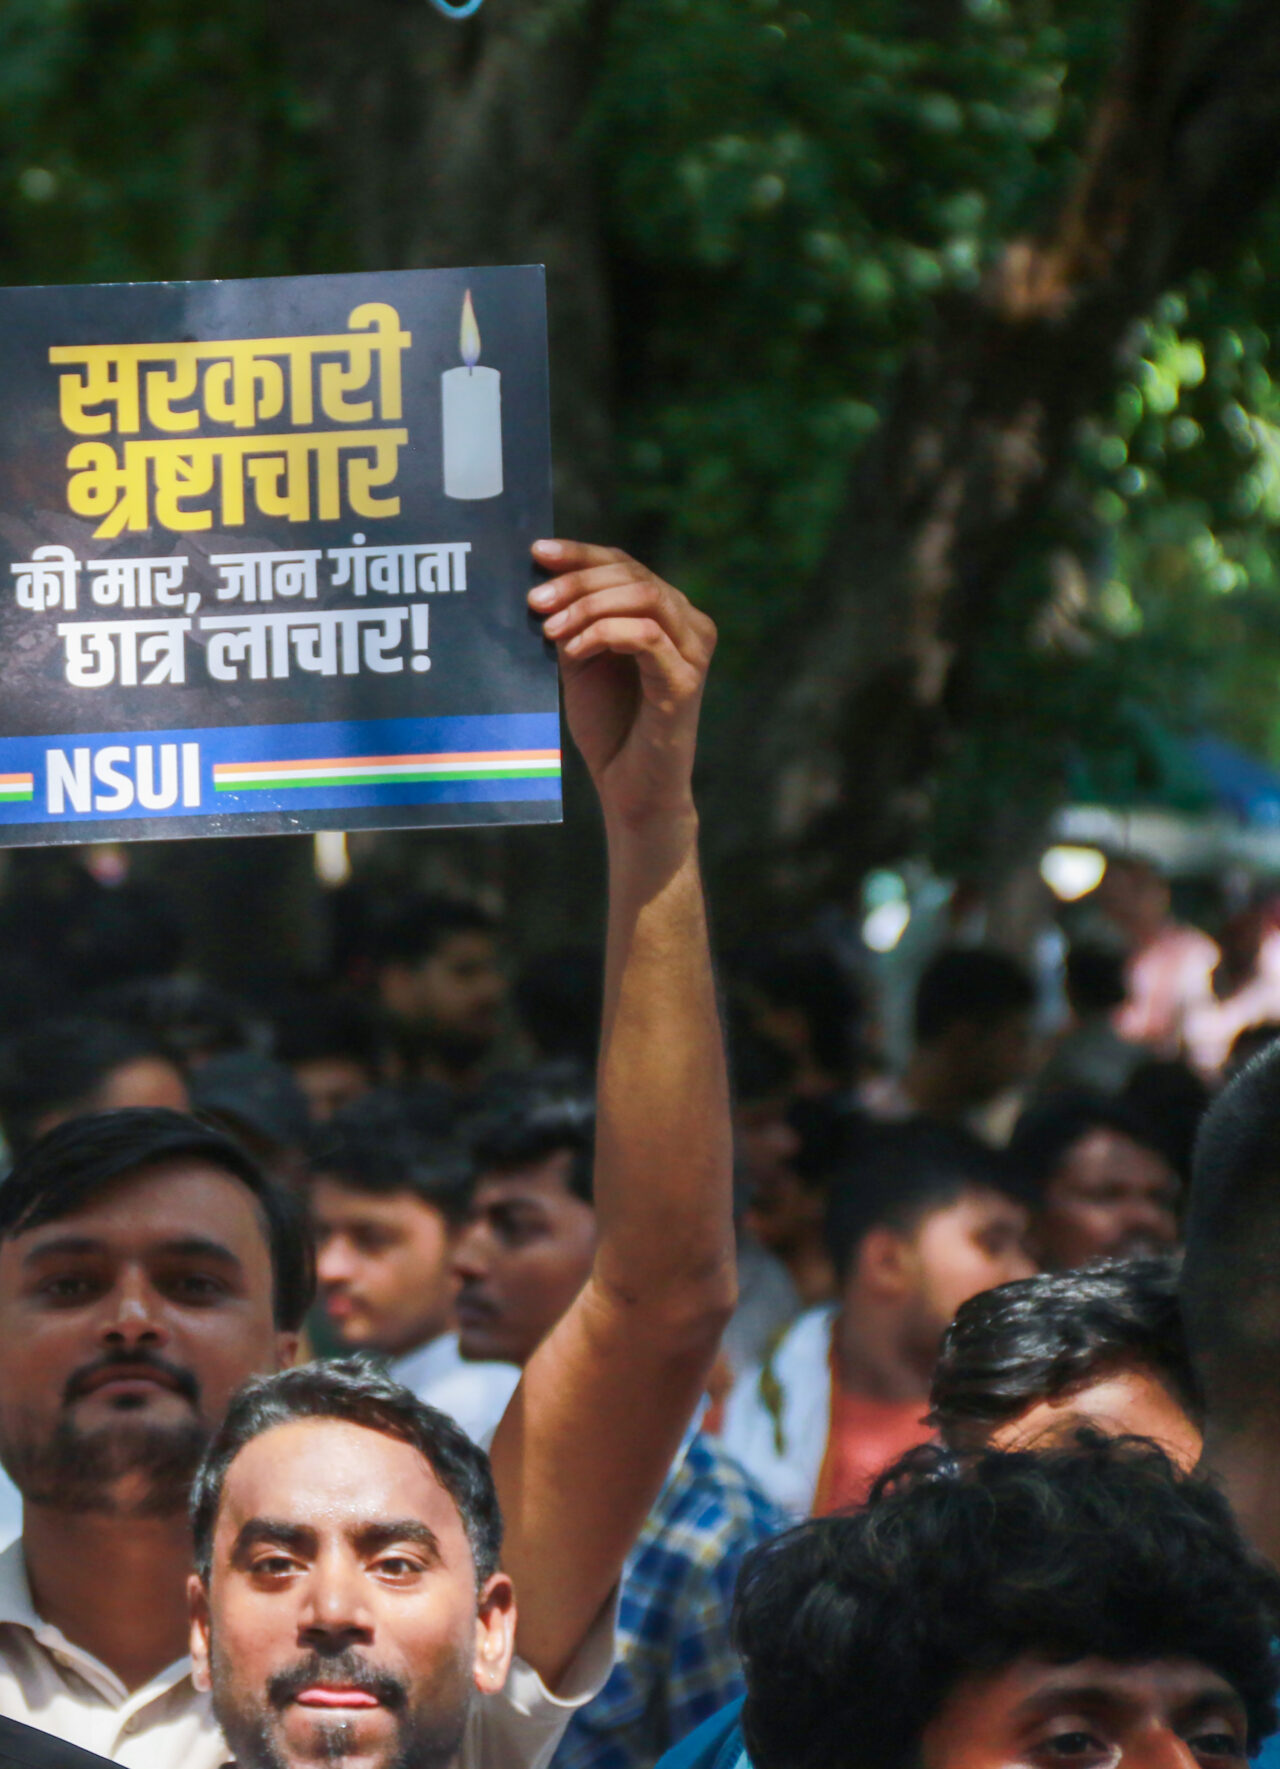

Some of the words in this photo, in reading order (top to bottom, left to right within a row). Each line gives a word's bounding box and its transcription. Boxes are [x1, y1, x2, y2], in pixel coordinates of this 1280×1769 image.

[48, 302, 412, 436] सरकारी
[65, 429, 410, 540] भ्रष्टाचार
[10, 544, 82, 612] की
[86, 556, 202, 615] मार,
[209, 549, 322, 602] जान
[327, 532, 472, 596] गंवाता
[57, 616, 193, 688] छात्र
[199, 603, 432, 681] लाचार!
[45, 741, 203, 816] NSUI
